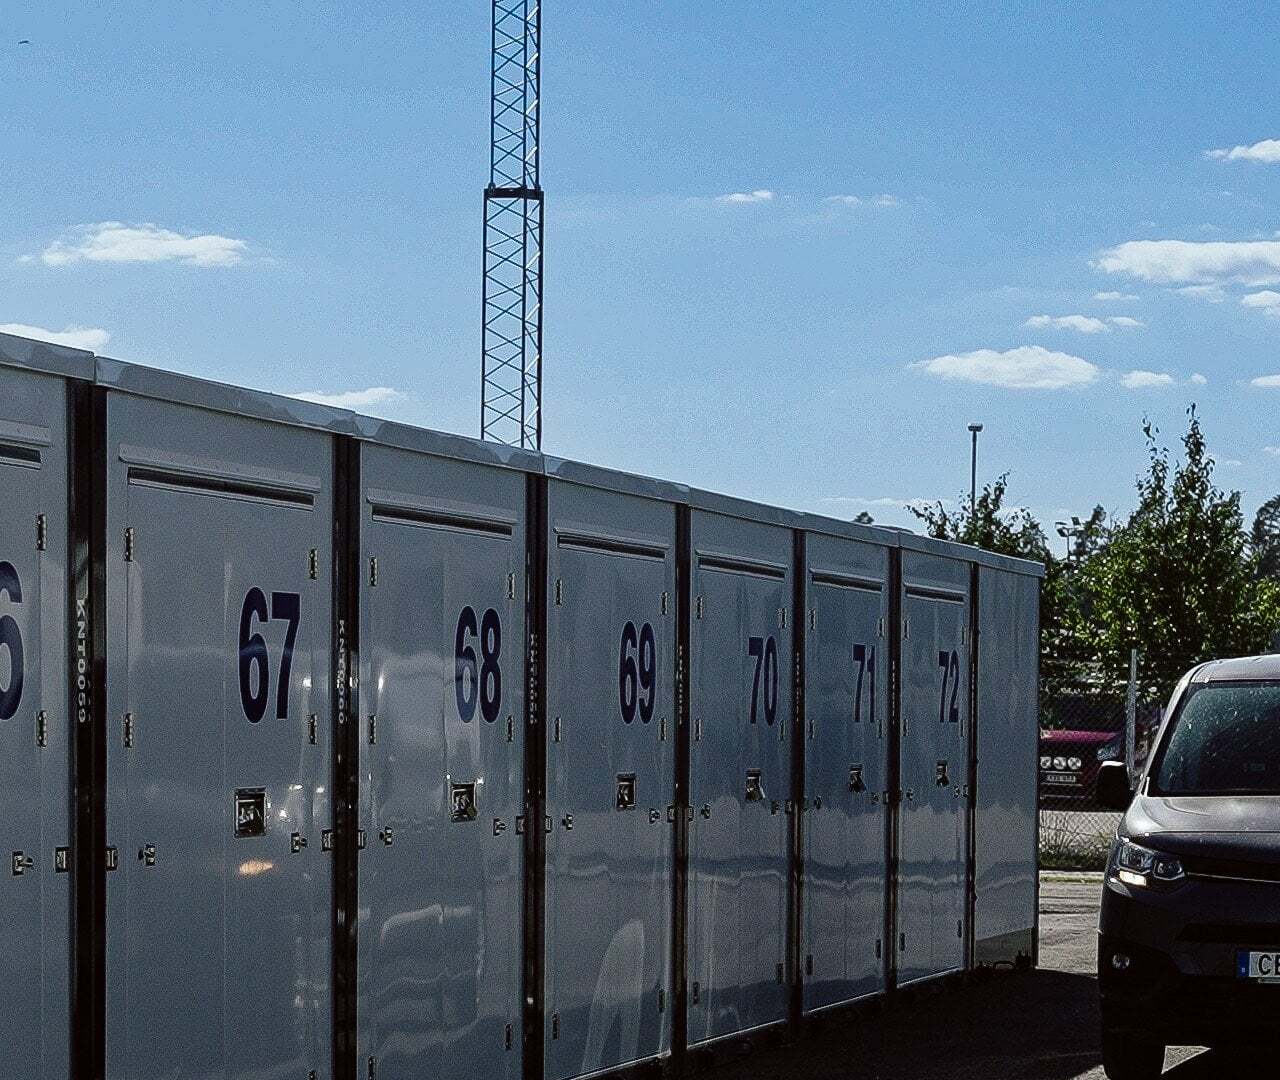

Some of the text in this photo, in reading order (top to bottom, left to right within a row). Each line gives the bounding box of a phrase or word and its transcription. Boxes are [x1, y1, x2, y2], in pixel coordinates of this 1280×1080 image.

[239, 587, 301, 723] 67
[455, 606, 502, 723] 68
[620, 621, 656, 724] 69
[749, 635, 778, 725] 70
[853, 644, 875, 723] 71
[938, 650, 960, 723] 72
